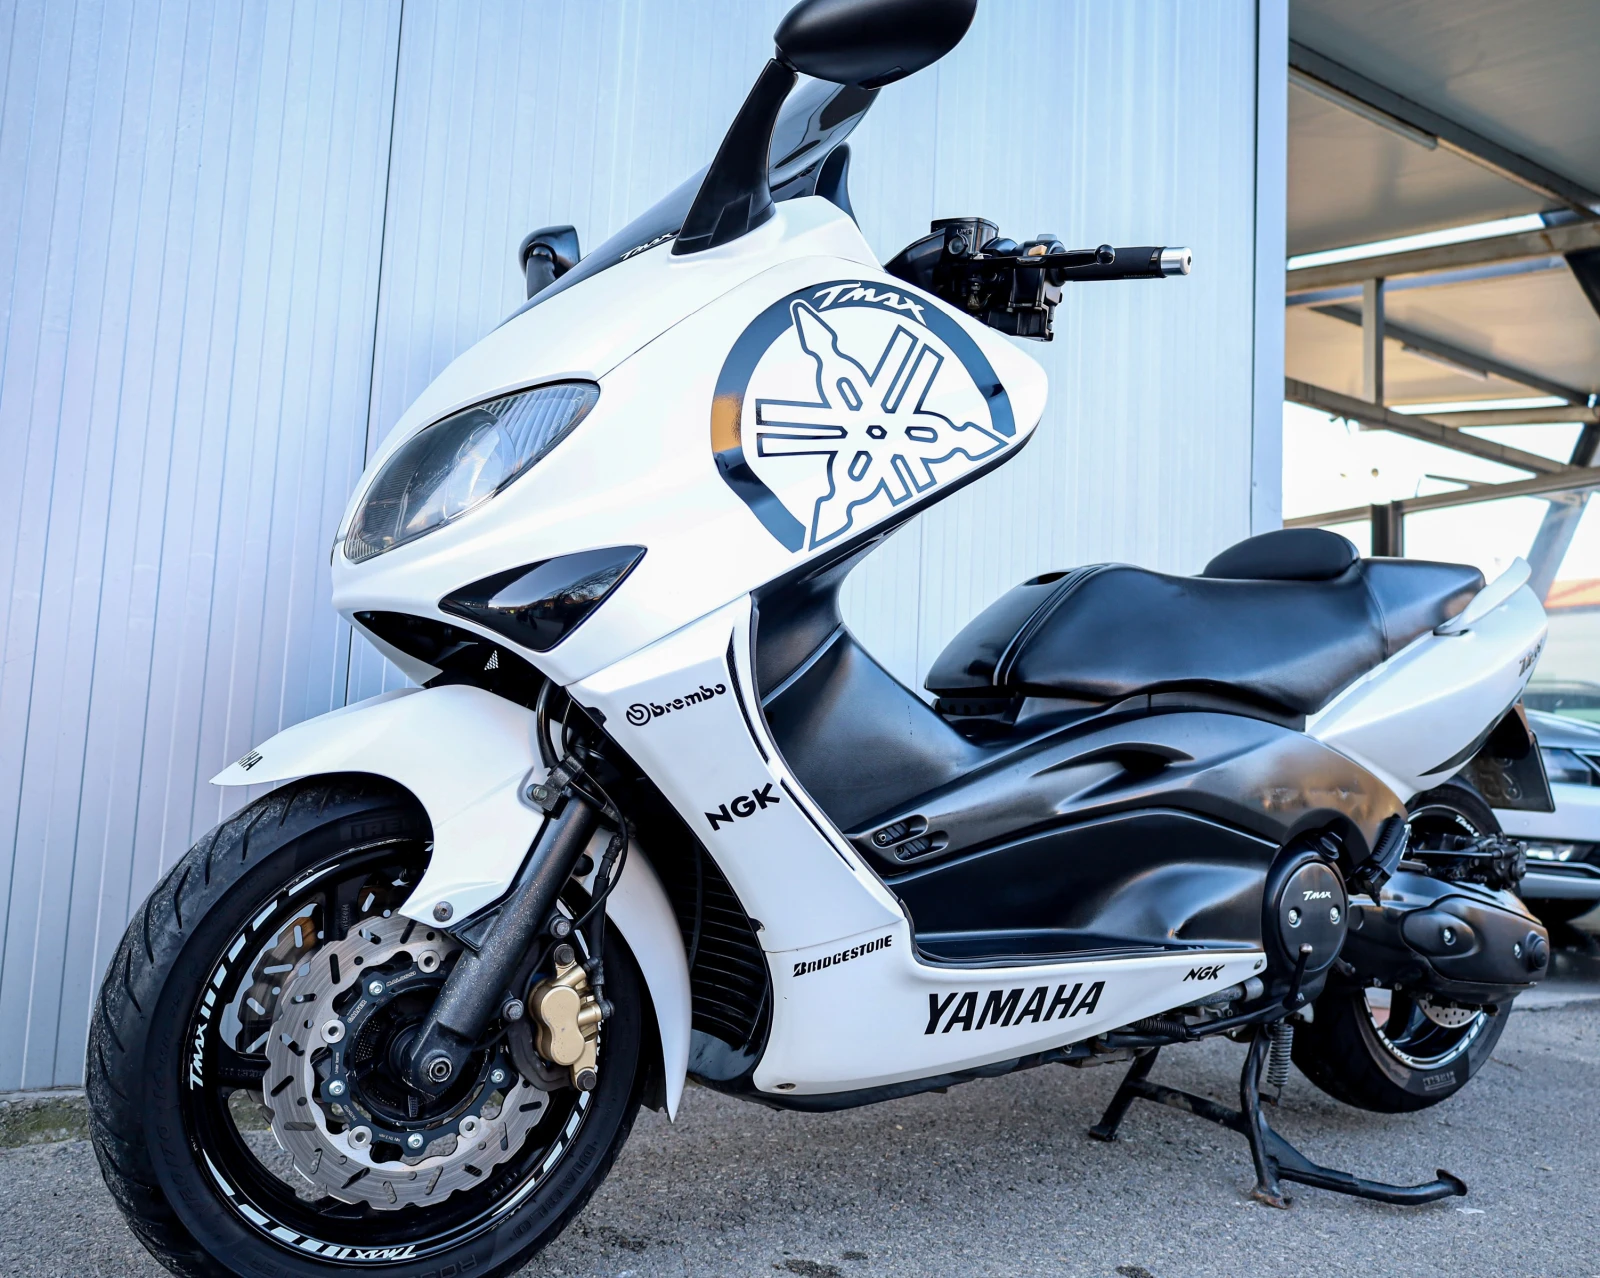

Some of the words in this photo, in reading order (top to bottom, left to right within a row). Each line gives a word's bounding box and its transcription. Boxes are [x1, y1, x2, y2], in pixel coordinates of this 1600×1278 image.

[650, 683, 726, 717] brembo
[704, 782, 780, 831] NGK
[792, 935, 892, 977] BRIDGESTONE
[1183, 964, 1225, 981] NGK
[924, 981, 1106, 1035] YAMAHA
